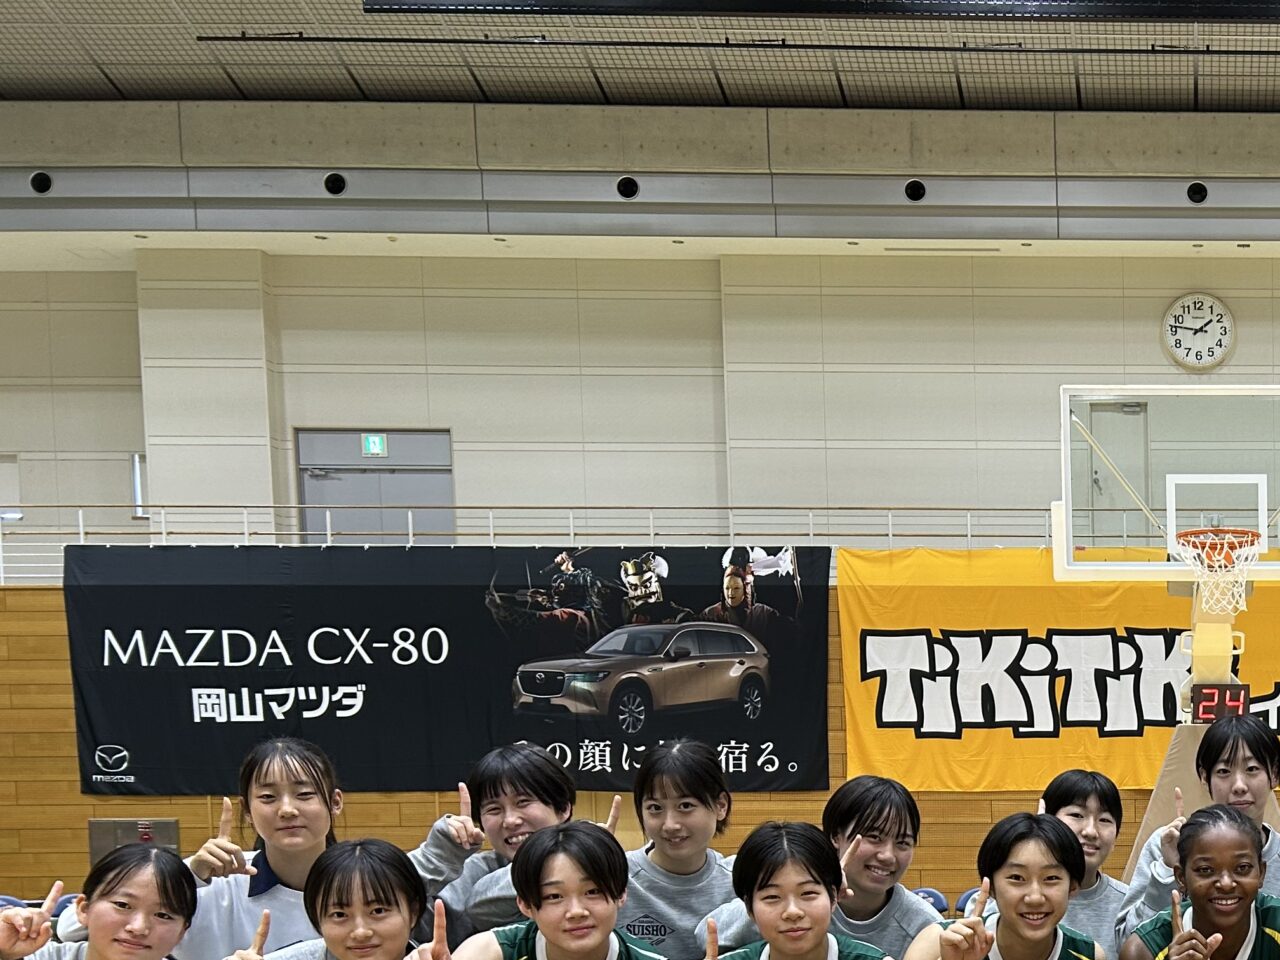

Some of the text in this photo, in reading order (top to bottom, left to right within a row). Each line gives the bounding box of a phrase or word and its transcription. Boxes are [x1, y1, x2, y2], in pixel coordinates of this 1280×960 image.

[1180, 304, 1191, 315] 11
[1192, 300, 1204, 311] 12
[1208, 304, 1214, 315] 1
[1173, 314, 1184, 325] 10
[1215, 313, 1224, 323] 2
[1170, 325, 1178, 336] 9
[1220, 325, 1228, 336] 3
[1174, 338, 1182, 349] 8
[1215, 338, 1223, 349] 4
[1184, 347, 1192, 358] 7
[1195, 350, 1203, 361] 6
[1207, 347, 1215, 358] 5
[102, 626, 450, 668] MAZDA CX-80
[860, 628, 1232, 738] TiKiTiK
[191, 683, 367, 723] 岡山マツダ
[1198, 688, 1245, 719] 24
[512, 739, 800, 773] の顔に宿る。
[626, 923, 667, 937] SUISHO
